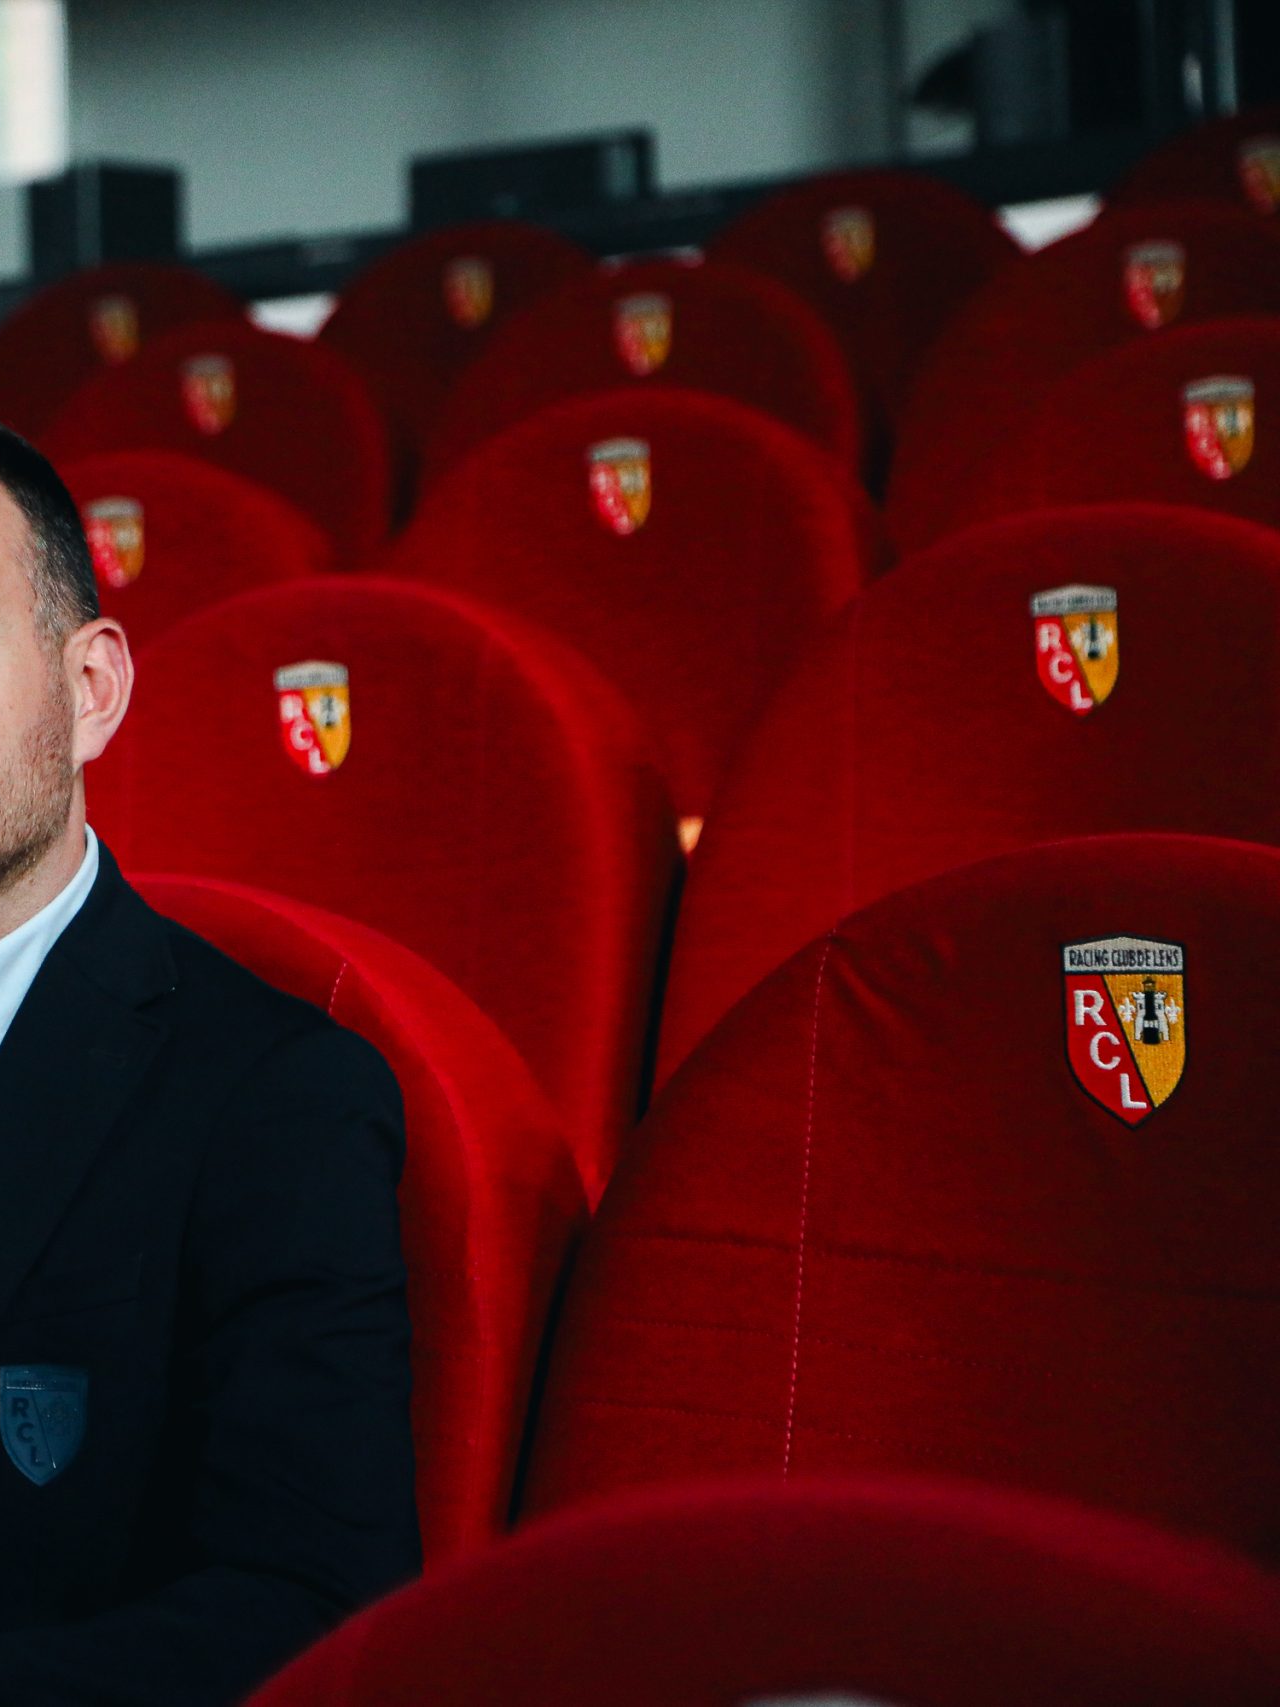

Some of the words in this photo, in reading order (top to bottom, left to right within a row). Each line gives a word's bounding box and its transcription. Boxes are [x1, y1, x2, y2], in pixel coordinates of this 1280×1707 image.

[1069, 949, 1108, 968] RACING
[1111, 949, 1136, 967] CLUB
[1137, 949, 1150, 966] DE
[1153, 949, 1179, 967] LENS
